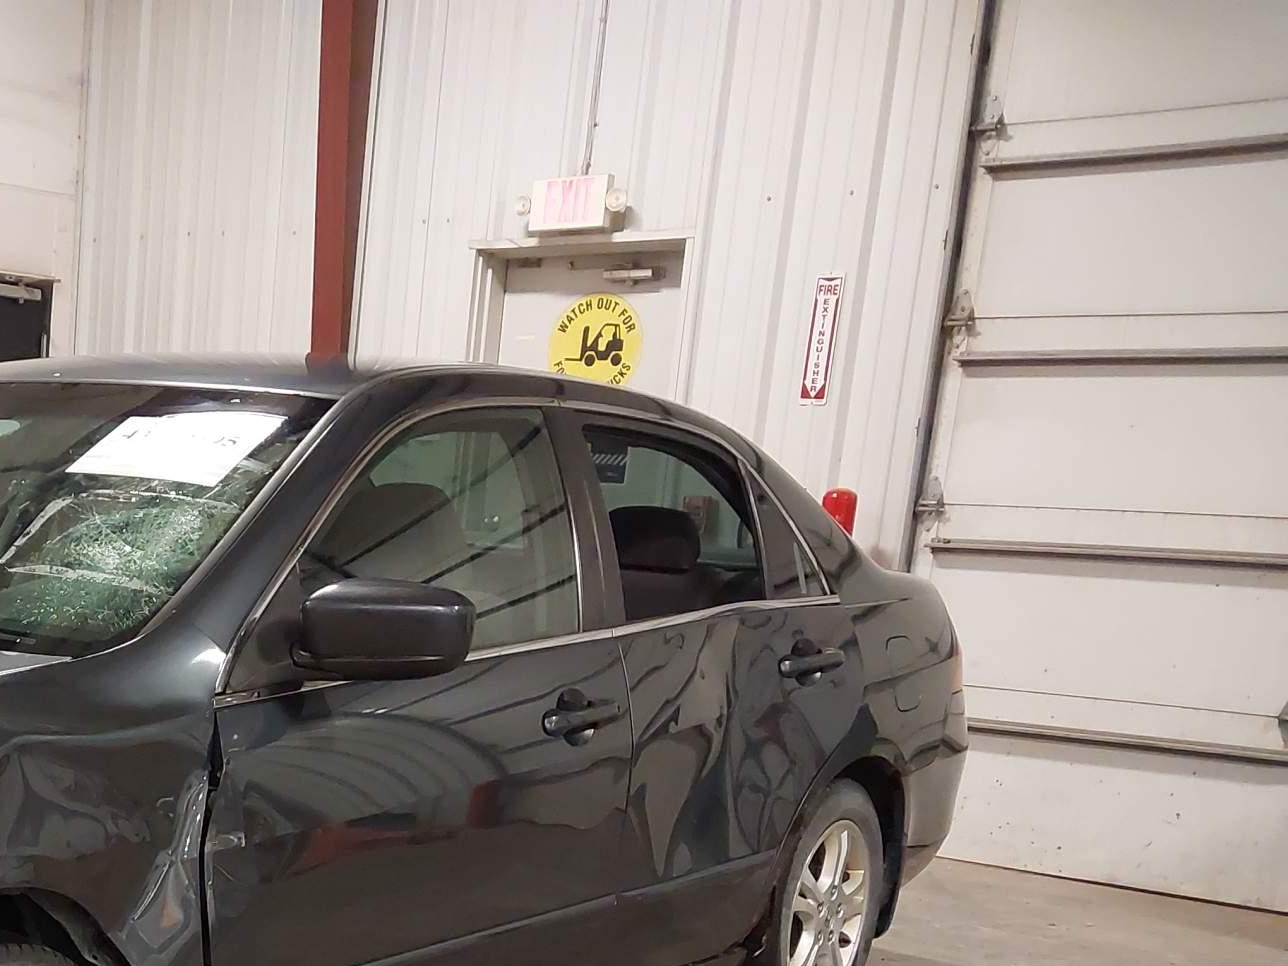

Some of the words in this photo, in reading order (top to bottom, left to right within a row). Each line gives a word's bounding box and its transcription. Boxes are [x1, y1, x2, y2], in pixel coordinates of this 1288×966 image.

[544, 178, 595, 224] EXIT
[818, 284, 839, 296] FIRE
[557, 299, 593, 334] WATCH
[597, 297, 620, 313] OUT
[618, 306, 636, 334] FOR
[810, 298, 831, 392] EXTINGUISHER
